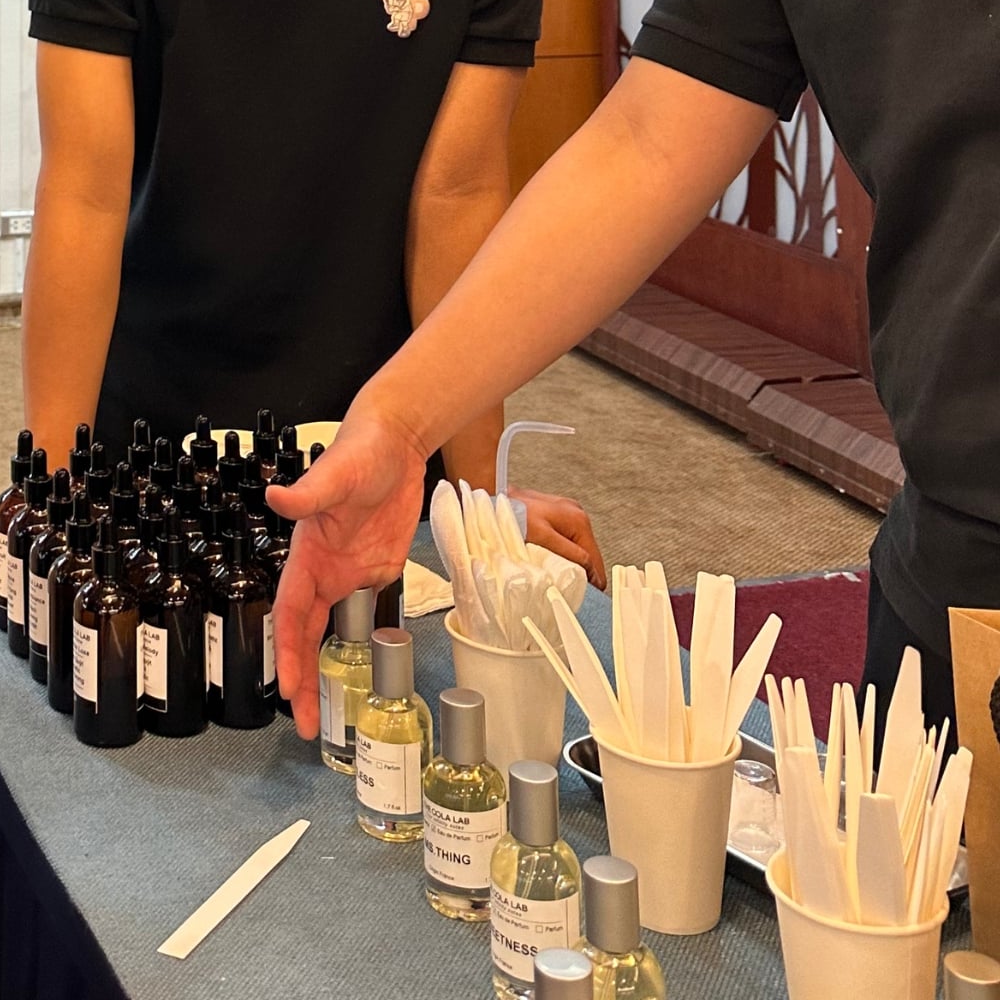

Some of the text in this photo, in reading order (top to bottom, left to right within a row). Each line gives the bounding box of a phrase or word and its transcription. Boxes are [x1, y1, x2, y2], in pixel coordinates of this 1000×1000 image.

[361, 740, 372, 750] LAB
[383, 763, 401, 771] Parfum
[453, 815, 470, 825] LAB
[510, 901, 528, 913] LAB
[545, 925, 564, 933] Parfum
